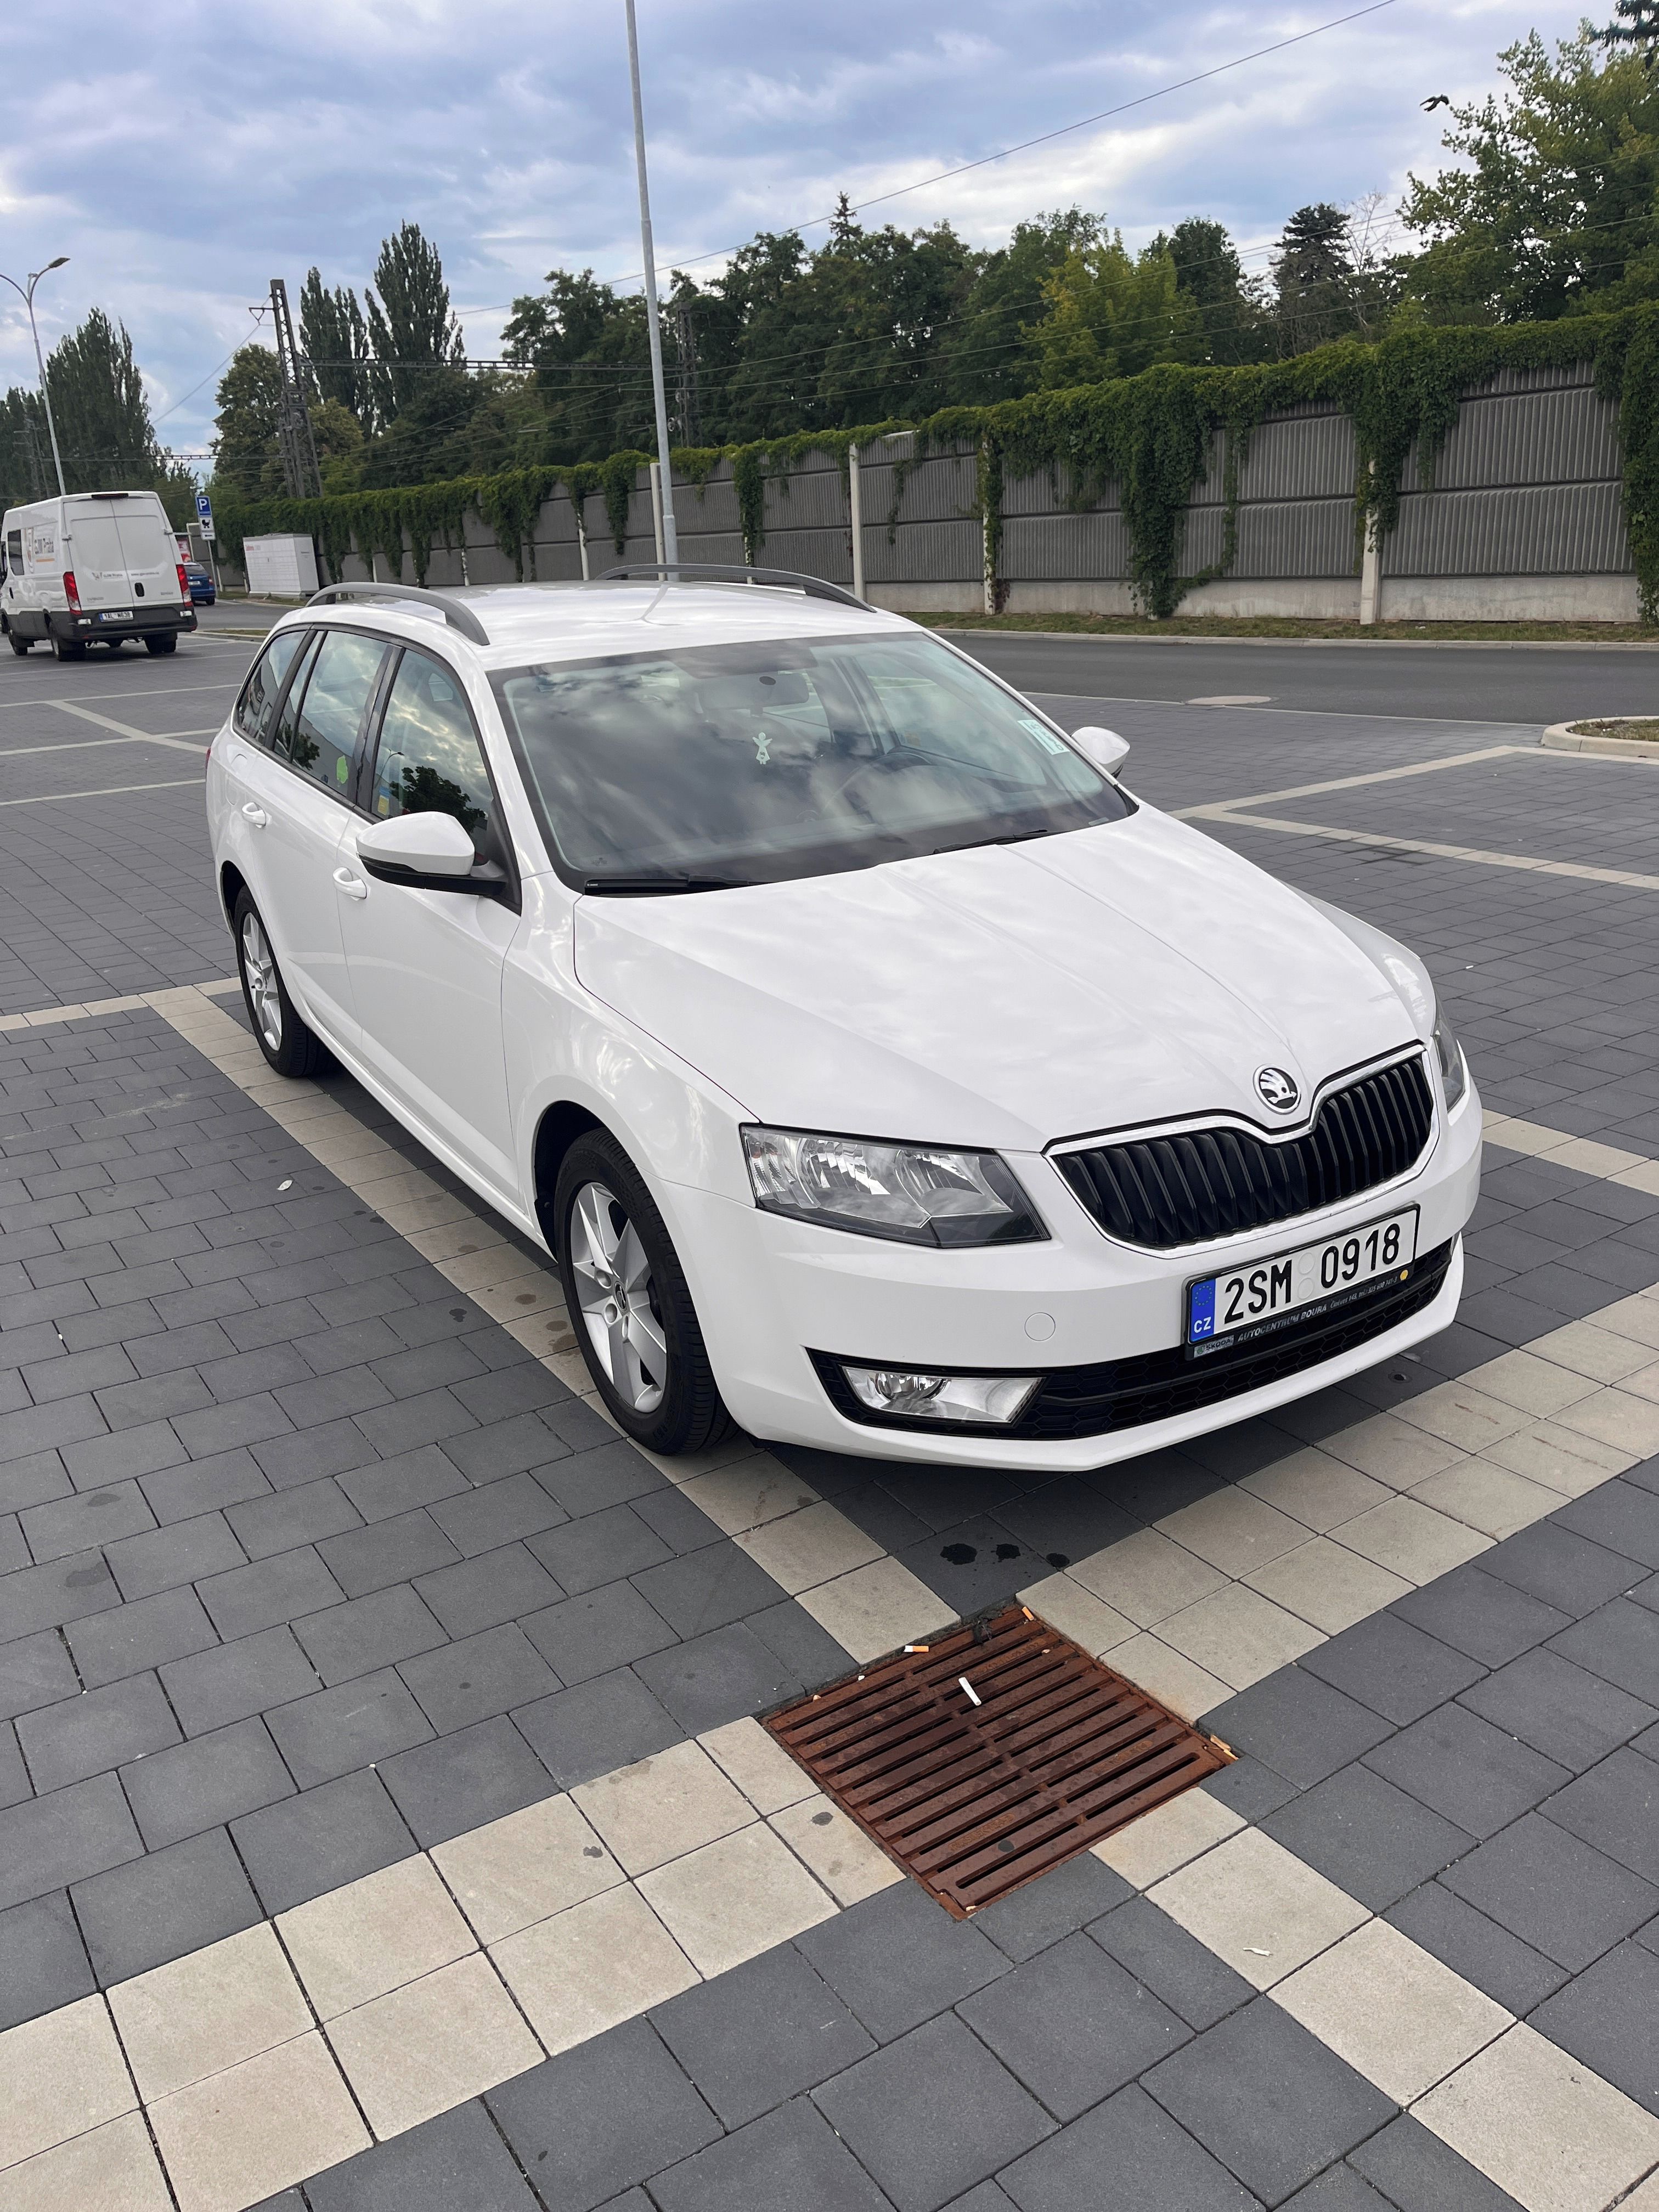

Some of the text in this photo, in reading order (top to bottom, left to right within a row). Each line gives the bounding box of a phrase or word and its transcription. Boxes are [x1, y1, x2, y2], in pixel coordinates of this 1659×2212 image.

[199, 499, 207, 510] P
[1224, 1223, 1400, 1324] 2SM 0918
[1194, 1317, 1211, 1333] CZ
